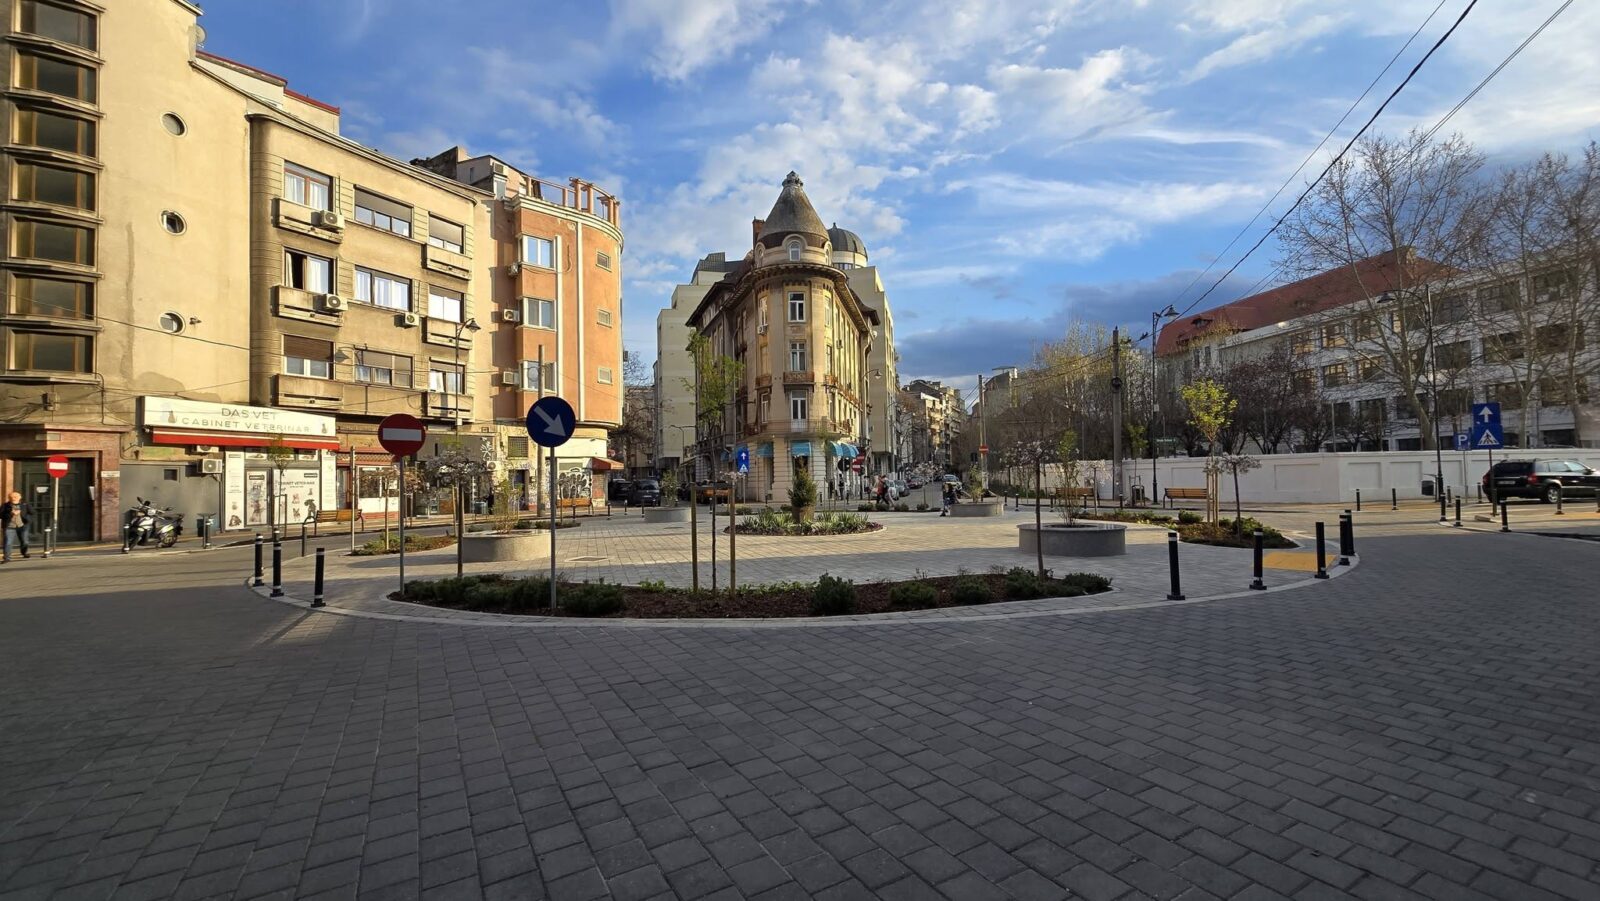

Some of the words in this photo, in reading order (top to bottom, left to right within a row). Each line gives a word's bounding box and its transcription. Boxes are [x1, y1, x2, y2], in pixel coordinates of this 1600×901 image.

[221, 408, 250, 418] DAS
[253, 410, 278, 420] VET
[181, 417, 240, 428] CABINET
[245, 422, 311, 432] VETERINAR
[1458, 435, 1468, 446] P
